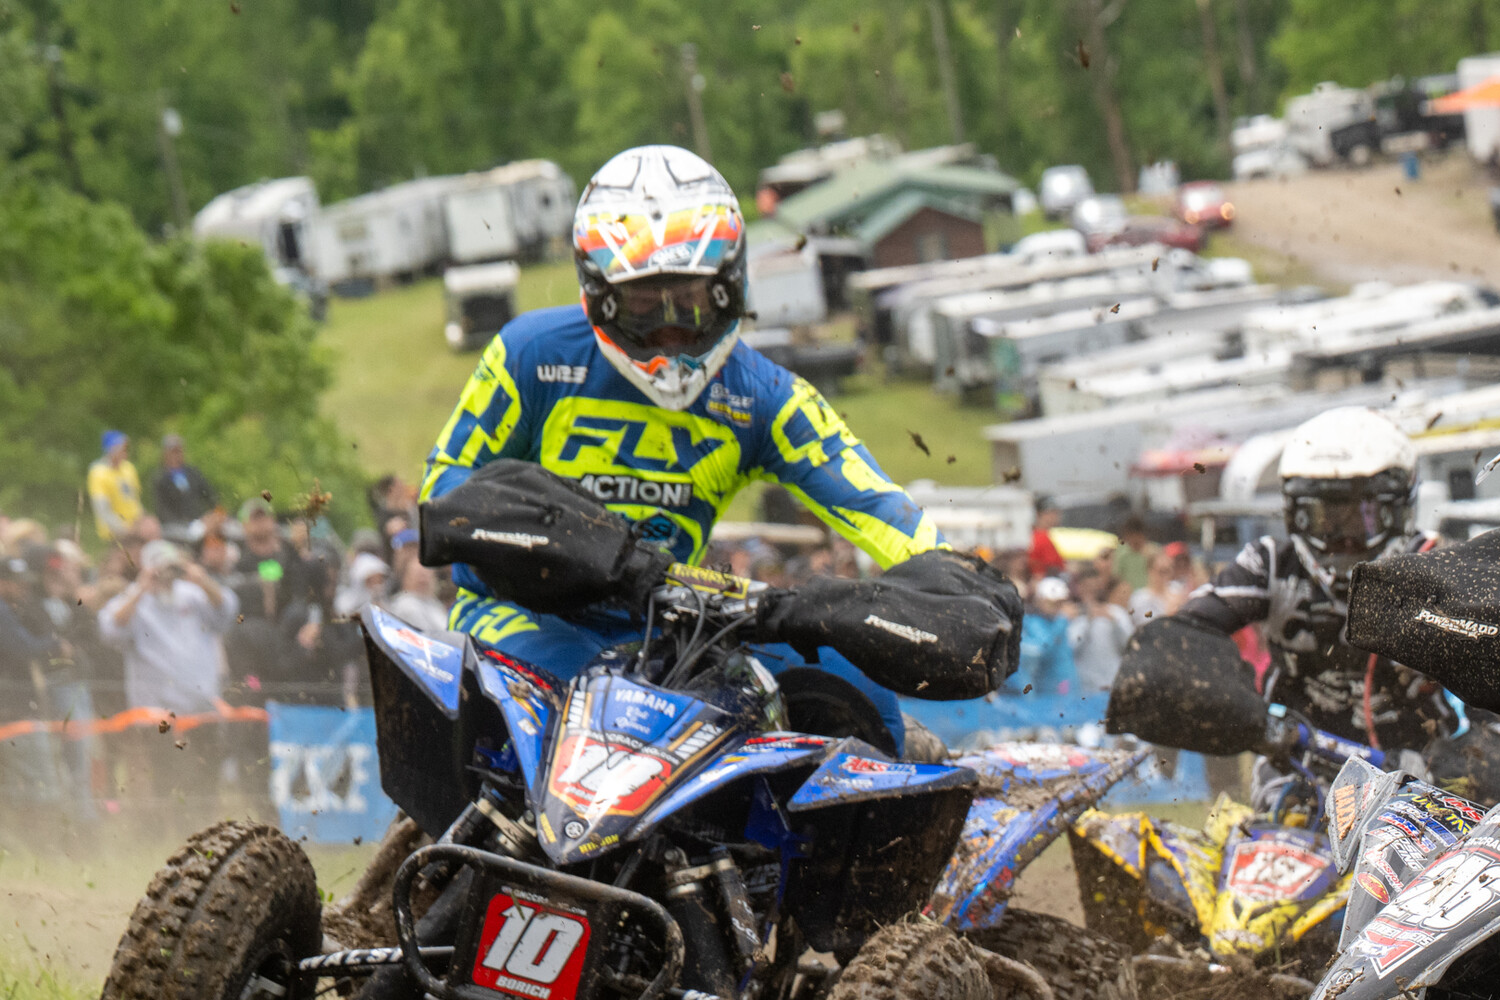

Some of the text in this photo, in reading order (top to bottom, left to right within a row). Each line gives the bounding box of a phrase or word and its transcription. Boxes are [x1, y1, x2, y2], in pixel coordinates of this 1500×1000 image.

[557, 416, 724, 472] FLY
[615, 688, 676, 718] YAMAHA
[482, 903, 584, 984] 10
[495, 975, 551, 1000] BORICH
